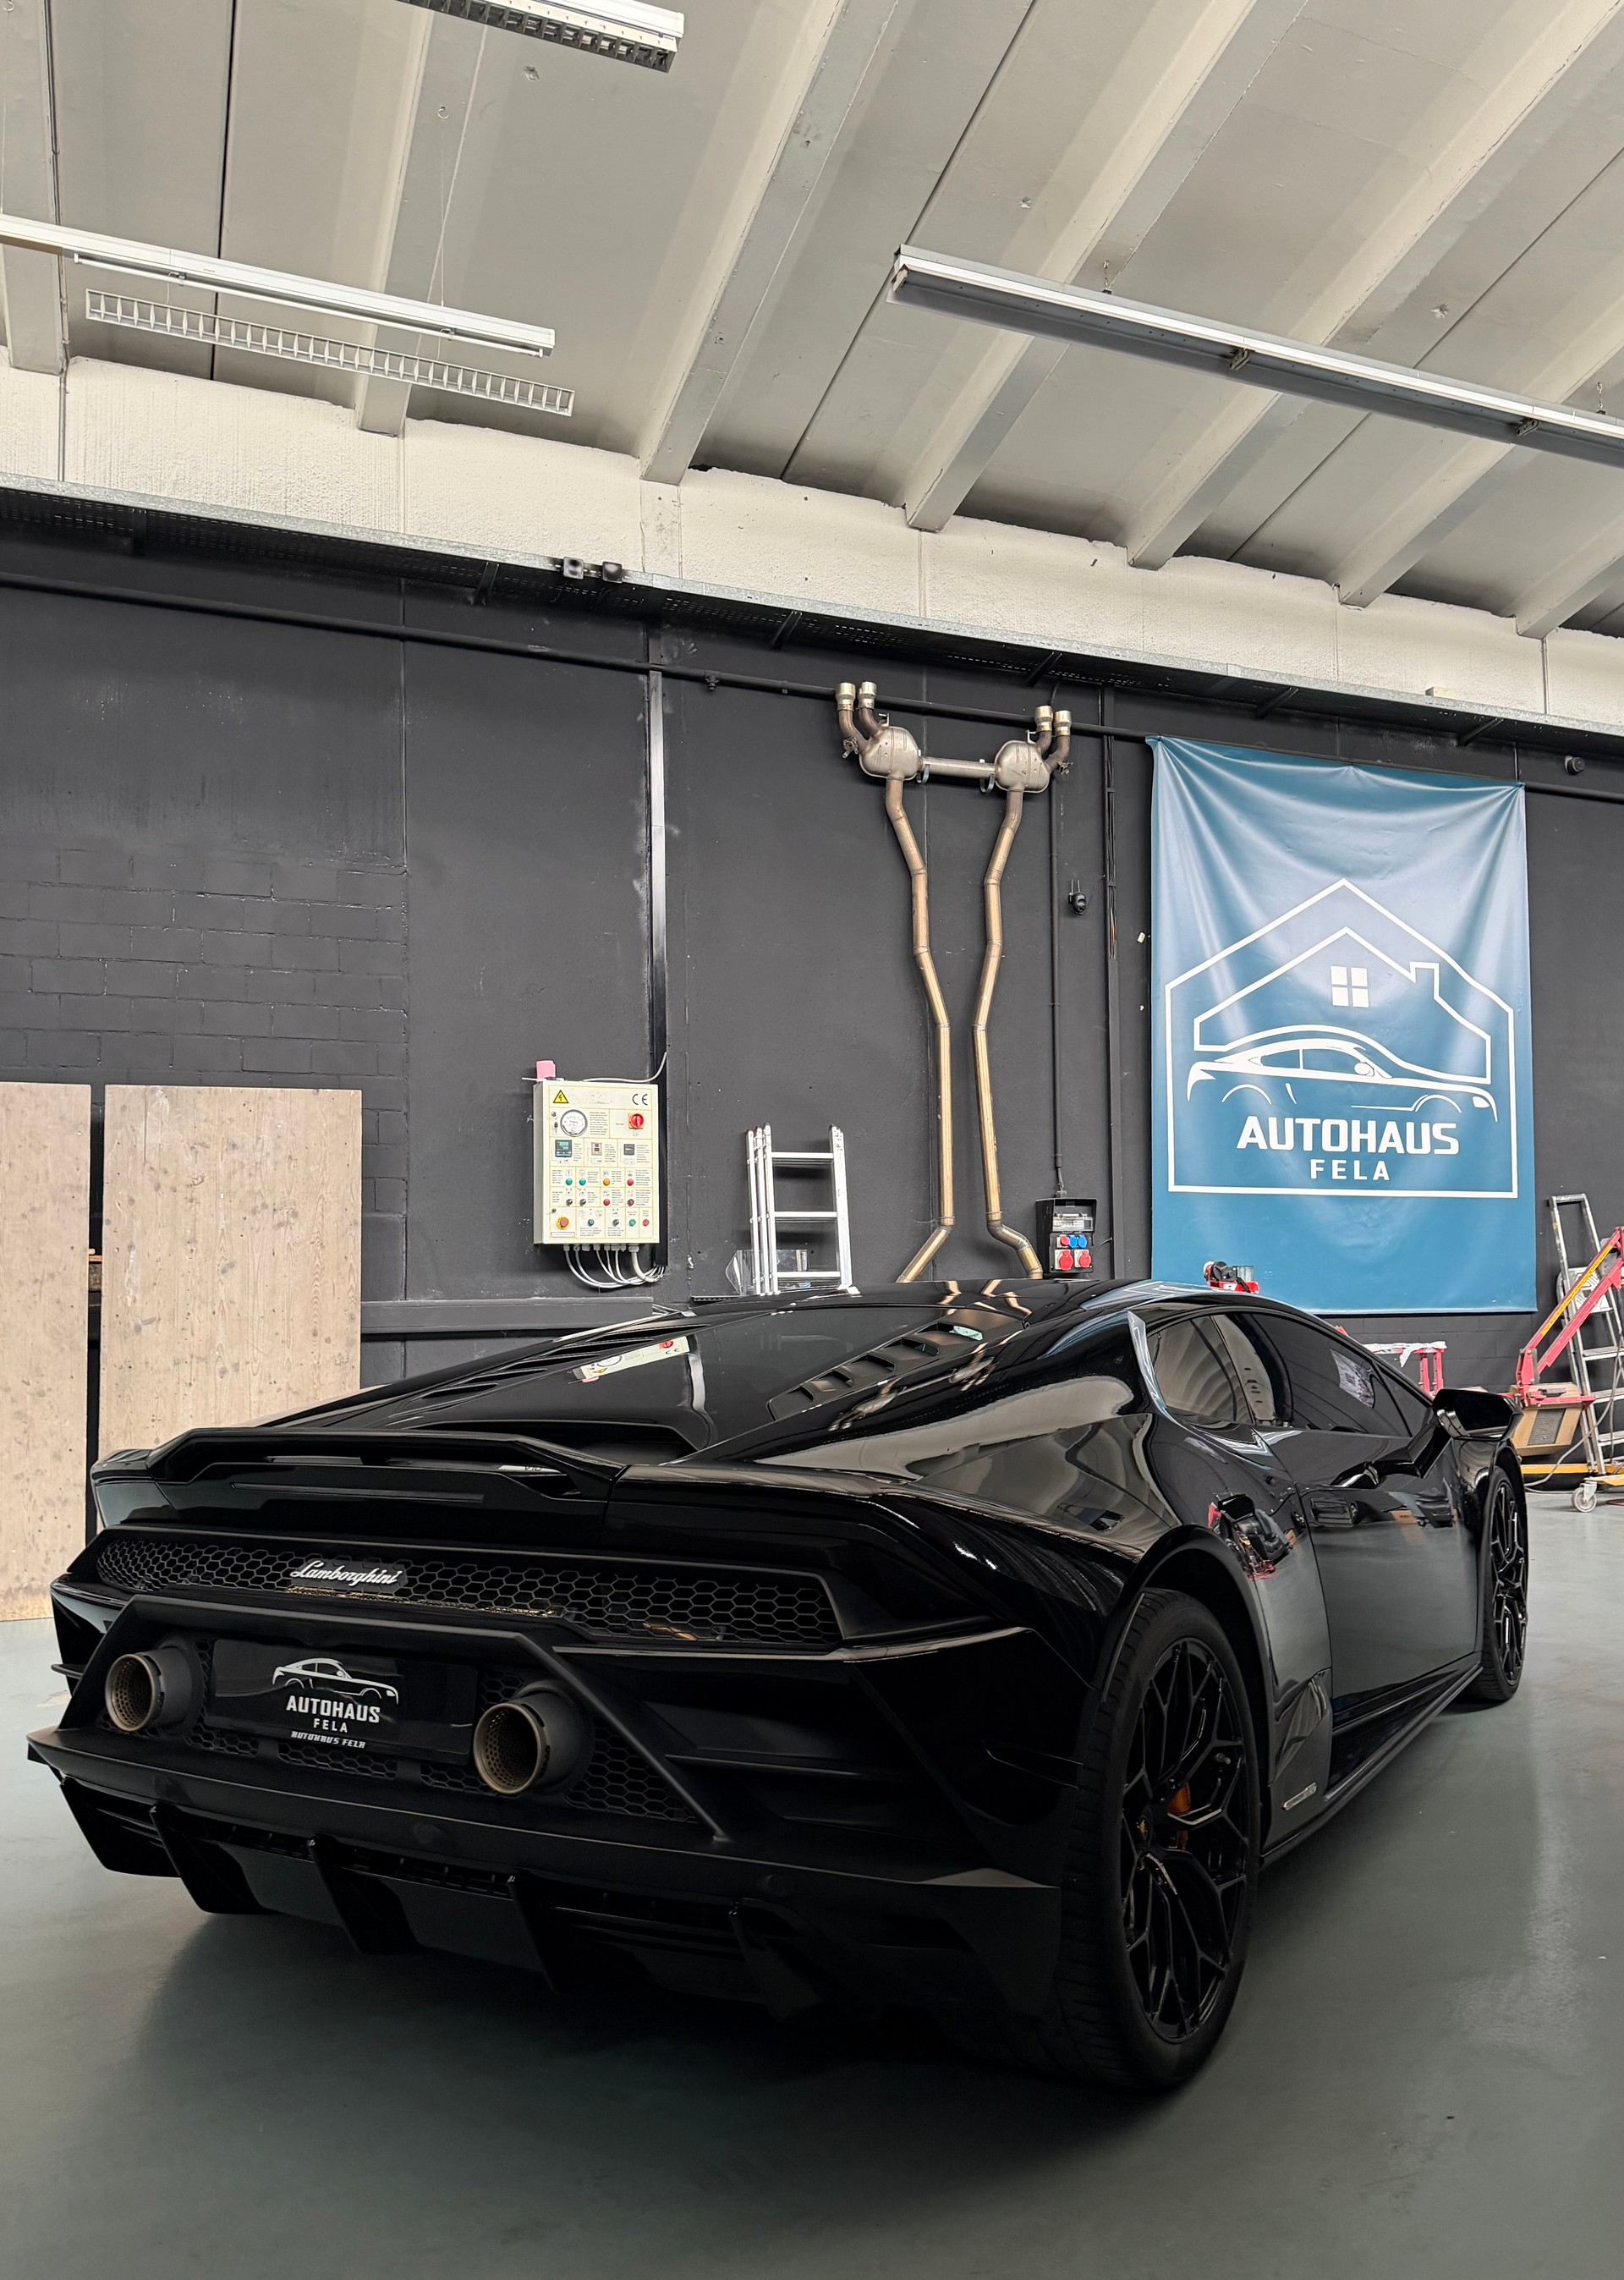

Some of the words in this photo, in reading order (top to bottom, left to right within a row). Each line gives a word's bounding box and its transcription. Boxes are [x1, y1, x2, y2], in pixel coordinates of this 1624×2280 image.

[632, 1093, 648, 1106] CE
[1237, 1115, 1459, 1155] AUTOHAUS
[1310, 1159, 1390, 1181] FELA
[289, 1560, 403, 1586] Lamborghini
[286, 1695, 381, 1723] AUTOHAUS
[313, 1718, 348, 1733] FELA
[291, 1731, 340, 1744] AUTOHAUS
[342, 1739, 365, 1749] FELA
